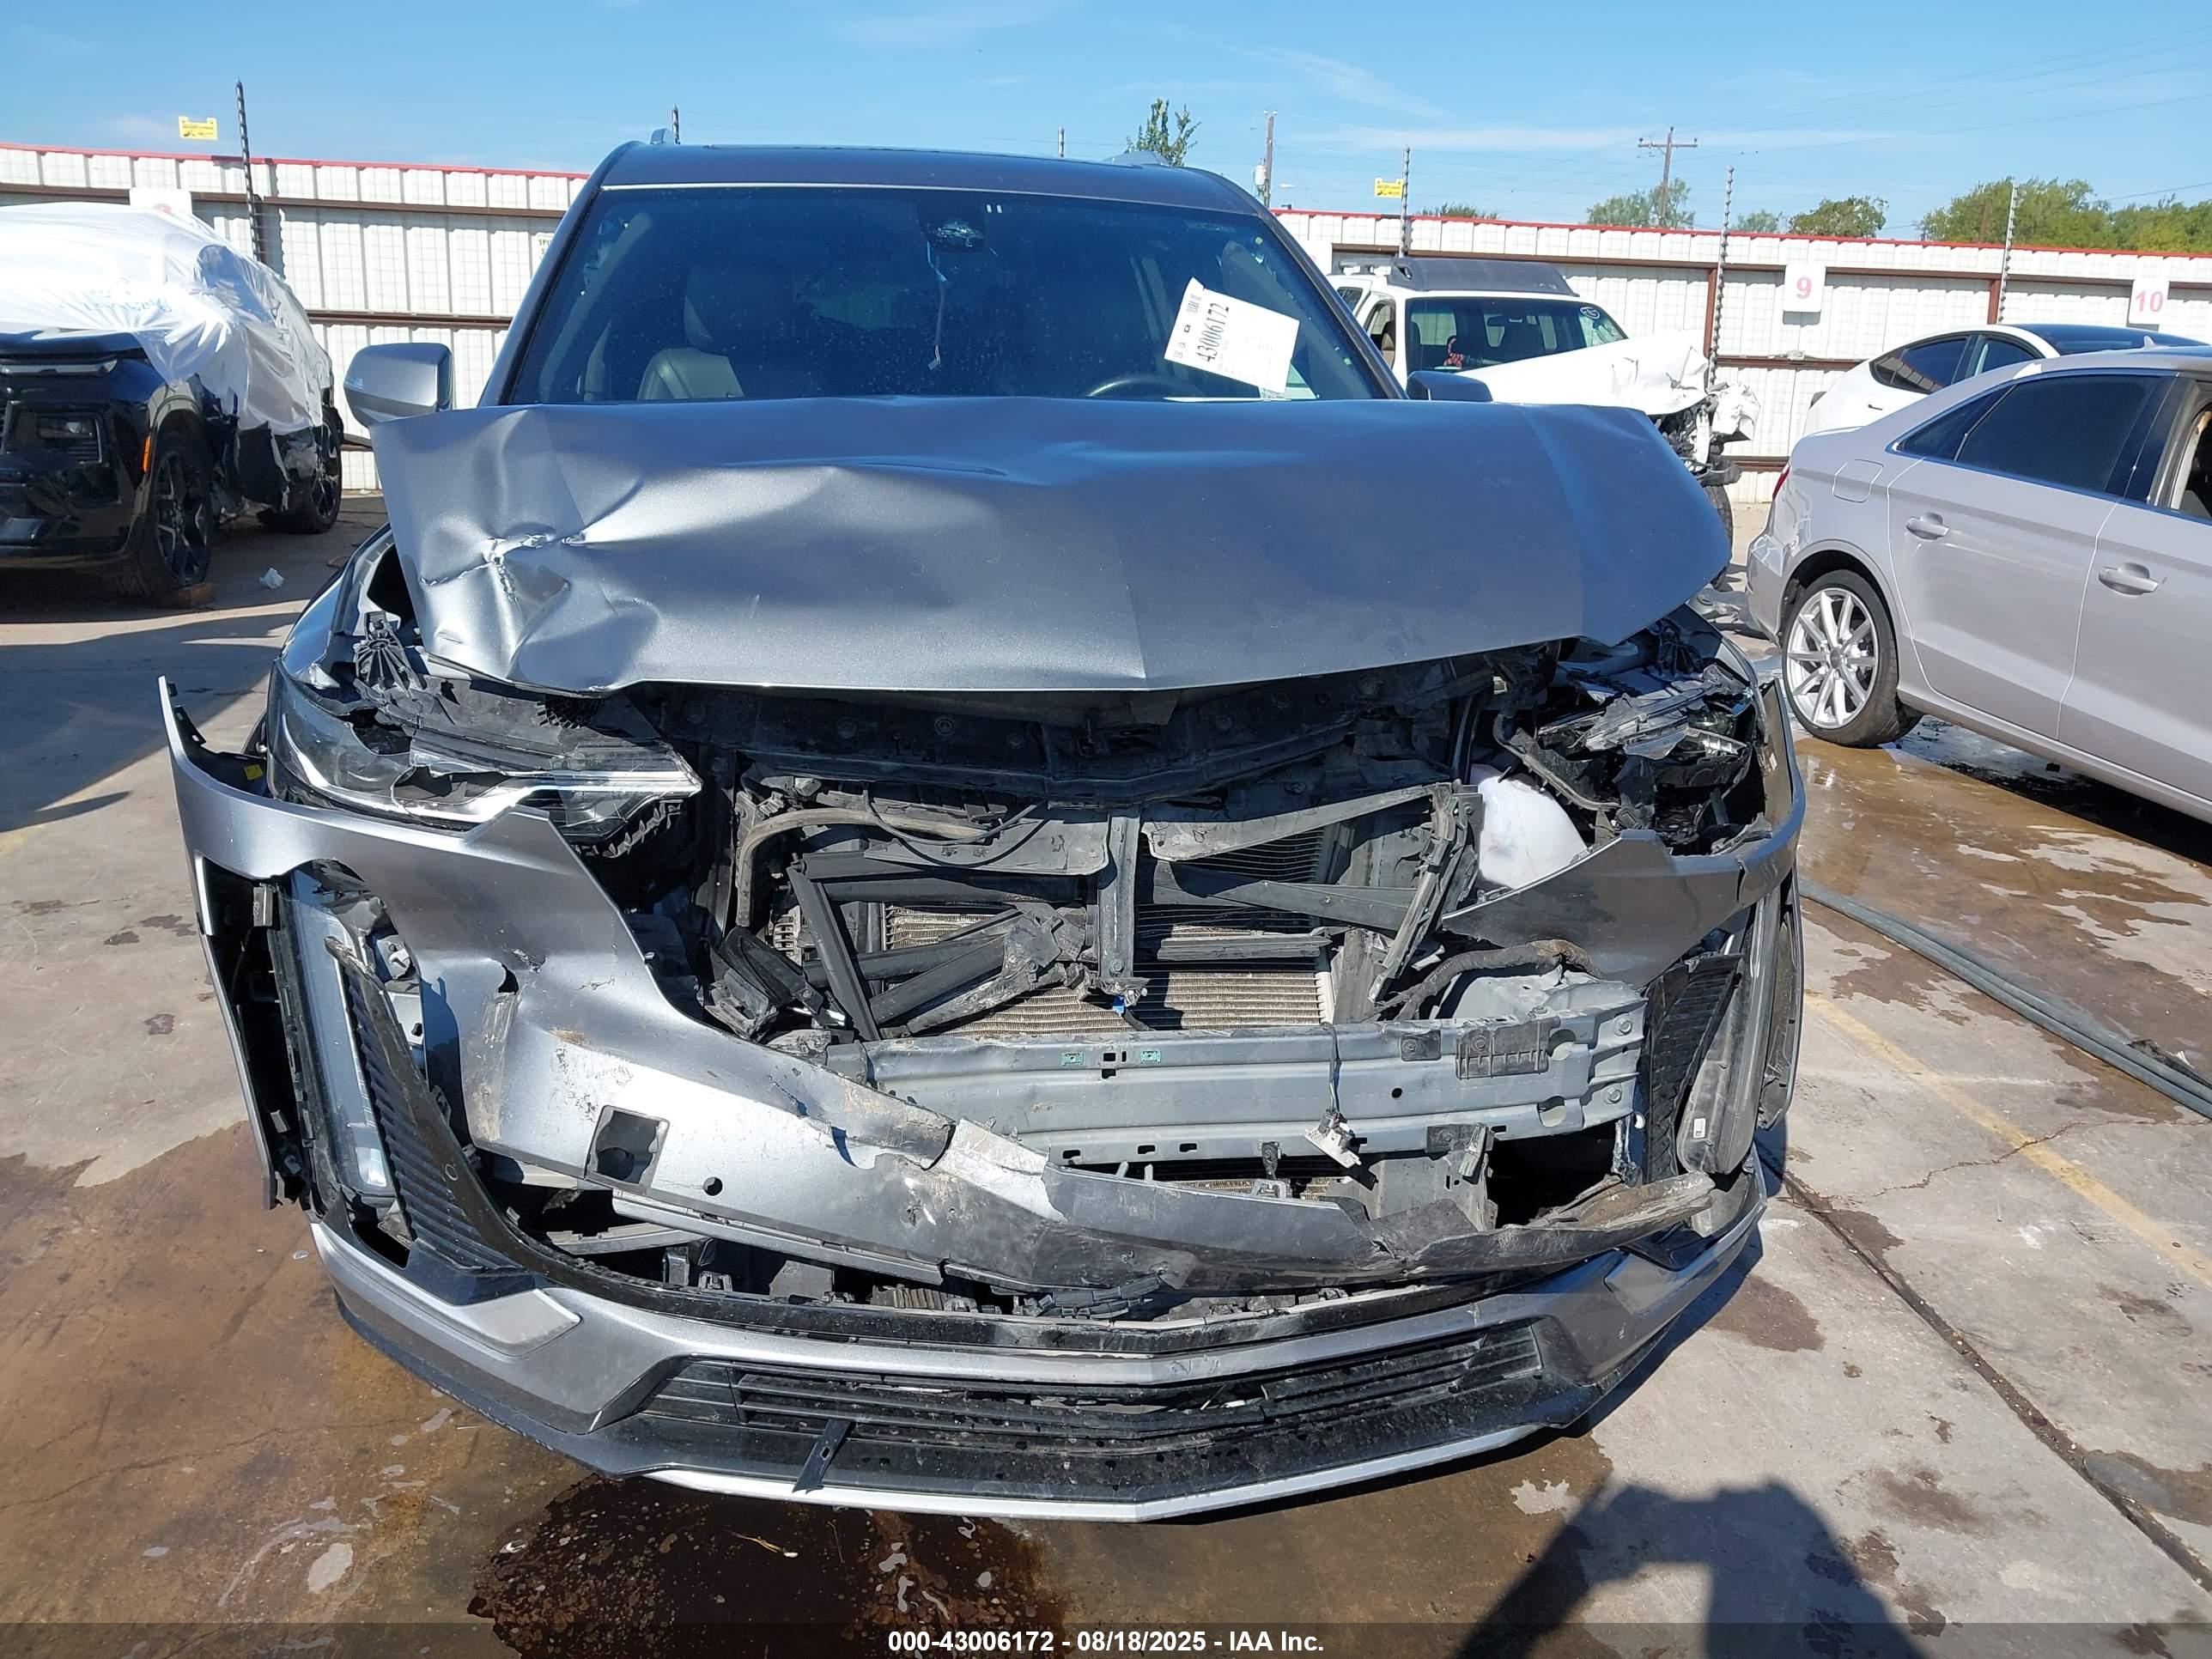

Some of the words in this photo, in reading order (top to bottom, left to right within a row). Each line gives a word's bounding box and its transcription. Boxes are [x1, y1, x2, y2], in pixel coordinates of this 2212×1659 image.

[1796, 276, 1812, 299] 9
[2136, 290, 2164, 313] 10
[1195, 302, 1230, 362] 43006172
